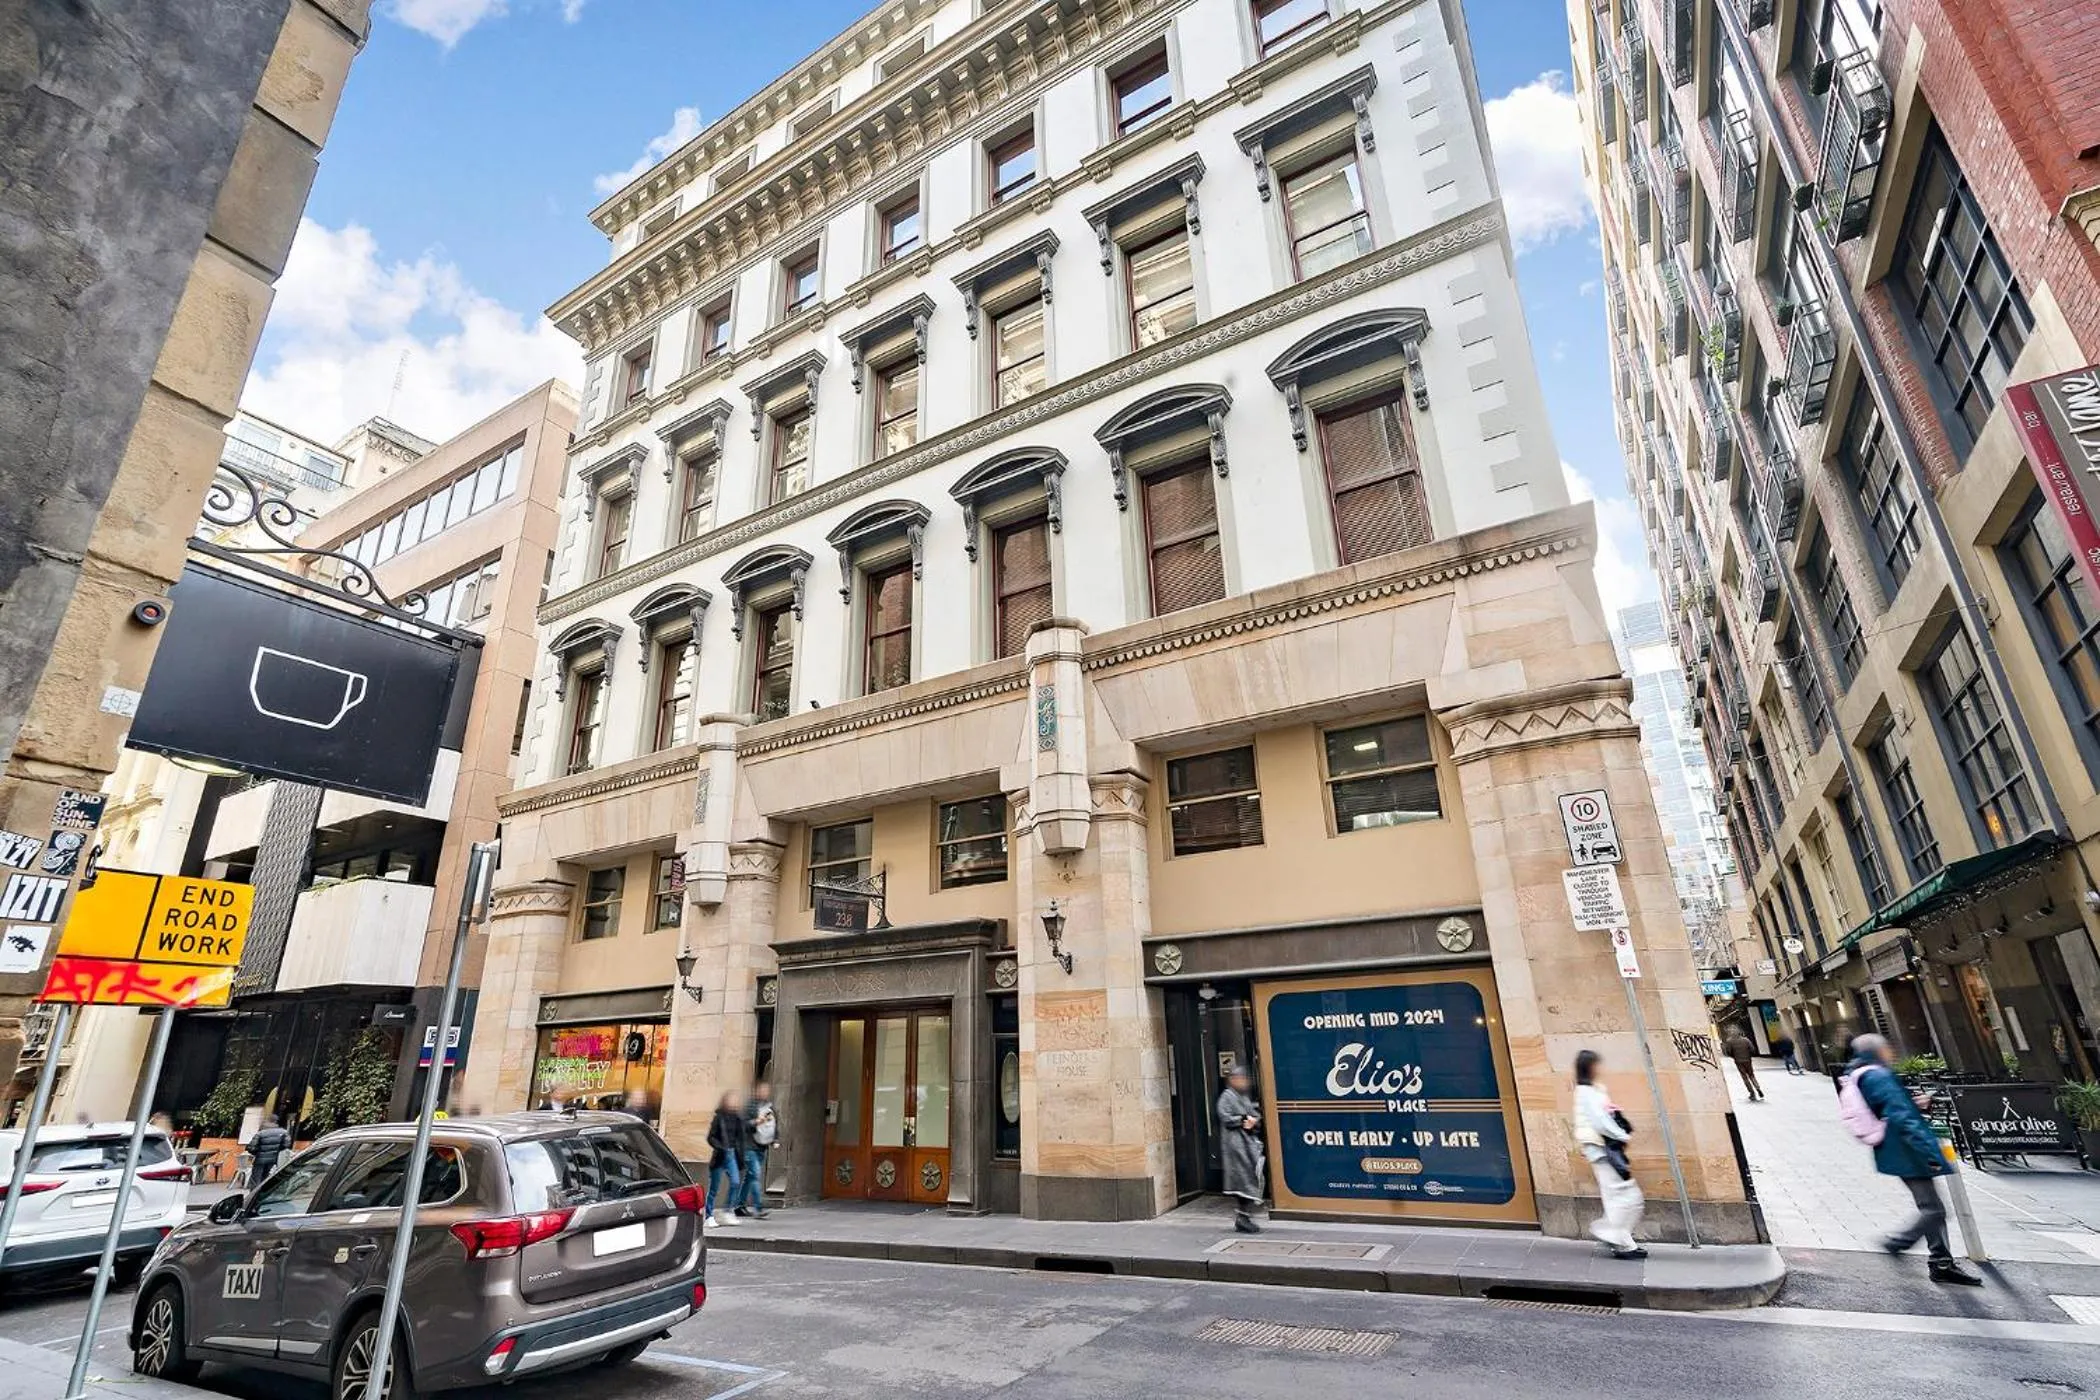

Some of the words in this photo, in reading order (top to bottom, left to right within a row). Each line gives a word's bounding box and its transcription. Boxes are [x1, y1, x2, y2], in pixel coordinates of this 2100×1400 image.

[2023, 410, 2040, 429] bar
[2047, 461, 2081, 516] restaurant
[57, 801, 80, 811] OF
[60, 790, 102, 804] LAND
[55, 807, 89, 820] SUN-
[1576, 803, 1594, 817] 10
[51, 816, 96, 830] SHINE
[1572, 822, 1608, 834] SHARED
[1581, 831, 1605, 841] ZONE
[0, 873, 68, 923] IZIT
[181, 885, 235, 907] END
[164, 908, 237, 932] ROAD
[158, 932, 234, 955] WORK
[1303, 1012, 1366, 1030] OPENING
[1370, 1011, 1400, 1027] MID
[1403, 1008, 1445, 1026] 2024
[1326, 1042, 1423, 1097] Elio's
[1387, 1099, 1428, 1113] PLACE
[1971, 1117, 2018, 1136] ginger
[2020, 1115, 2057, 1132] olive
[1303, 1130, 1345, 1147] OPEN
[1349, 1130, 1395, 1147] EARLY
[1412, 1130, 1434, 1147] UP
[1440, 1130, 1480, 1148] LATE
[227, 1268, 262, 1295] TAXI
